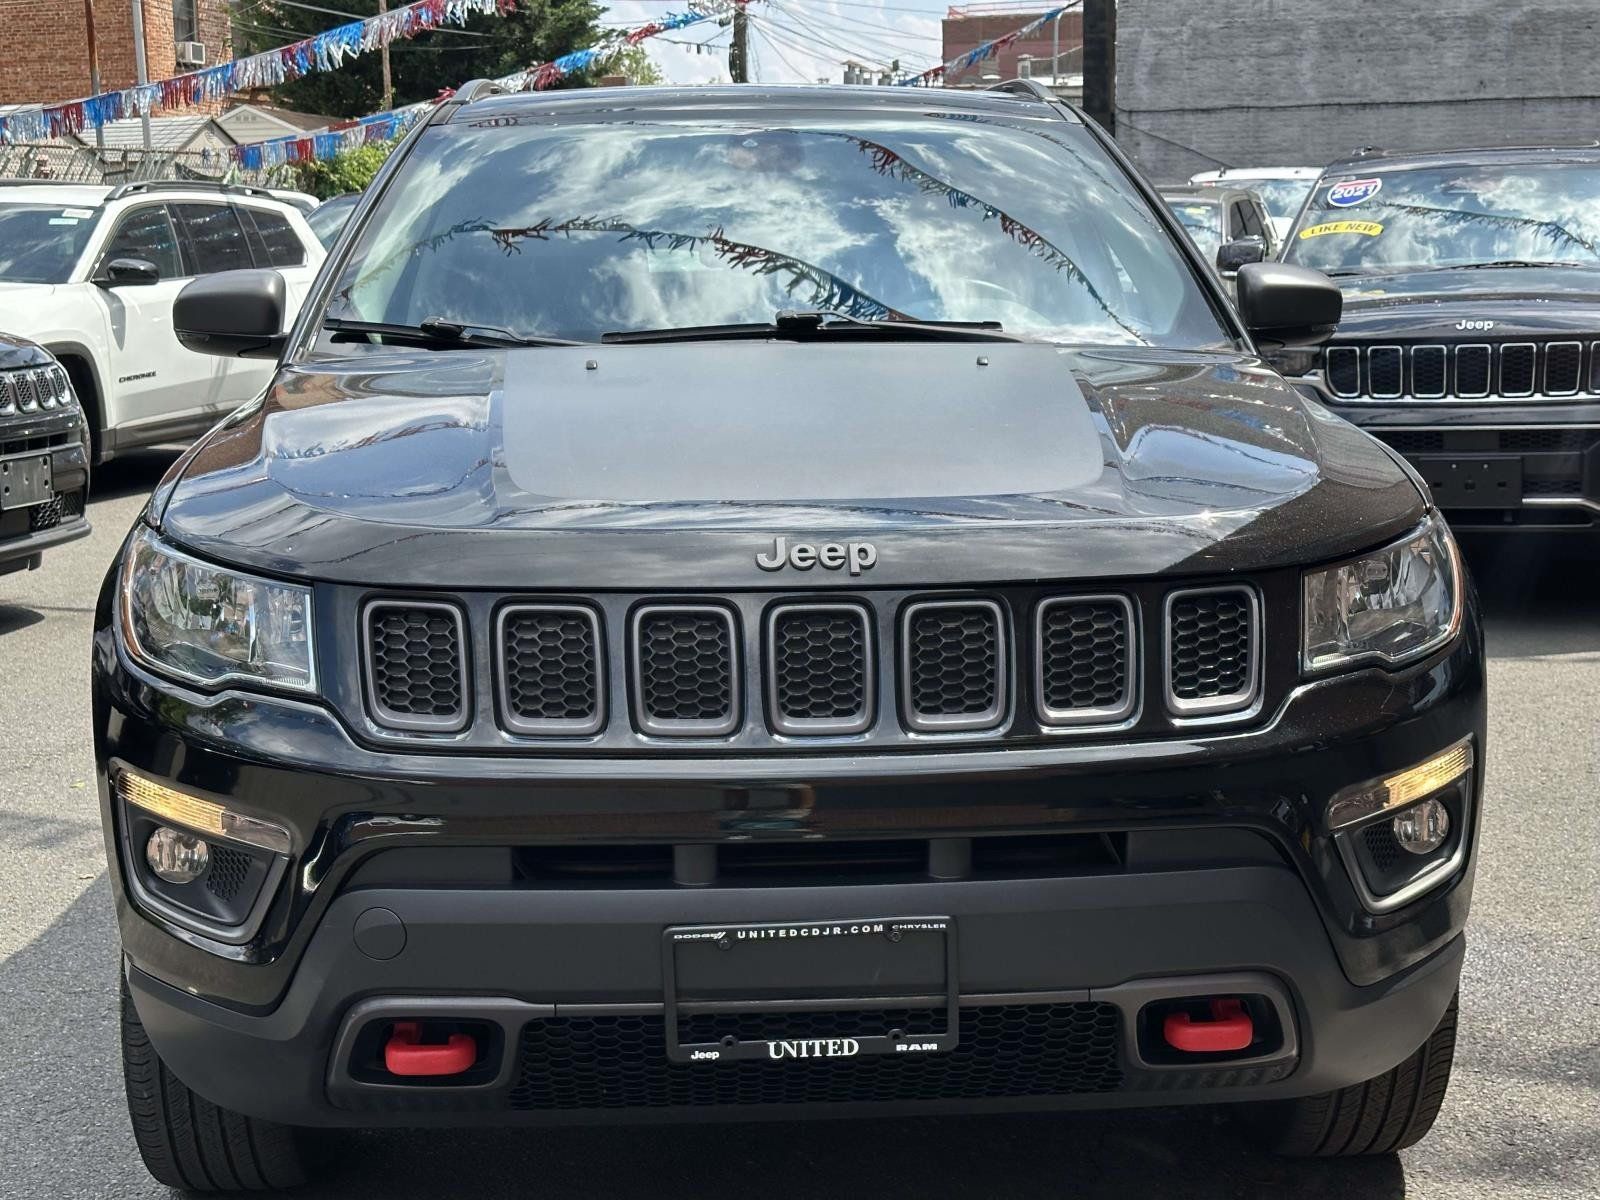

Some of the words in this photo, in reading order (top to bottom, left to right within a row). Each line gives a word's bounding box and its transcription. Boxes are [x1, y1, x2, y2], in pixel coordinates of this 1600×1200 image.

[1332, 186, 1375, 199] 2021
[1311, 224, 1341, 235] LIKE
[1345, 223, 1379, 232] NEW
[1455, 319, 1494, 331] Jeep
[118, 371, 157, 383] CHEROKEE
[756, 536, 877, 577] Jeep
[737, 925, 884, 939] UNITEDCDJR.COM
[767, 1038, 860, 1059] UNITED
[895, 1043, 938, 1051] RAM
[690, 1050, 720, 1060] Jeep
